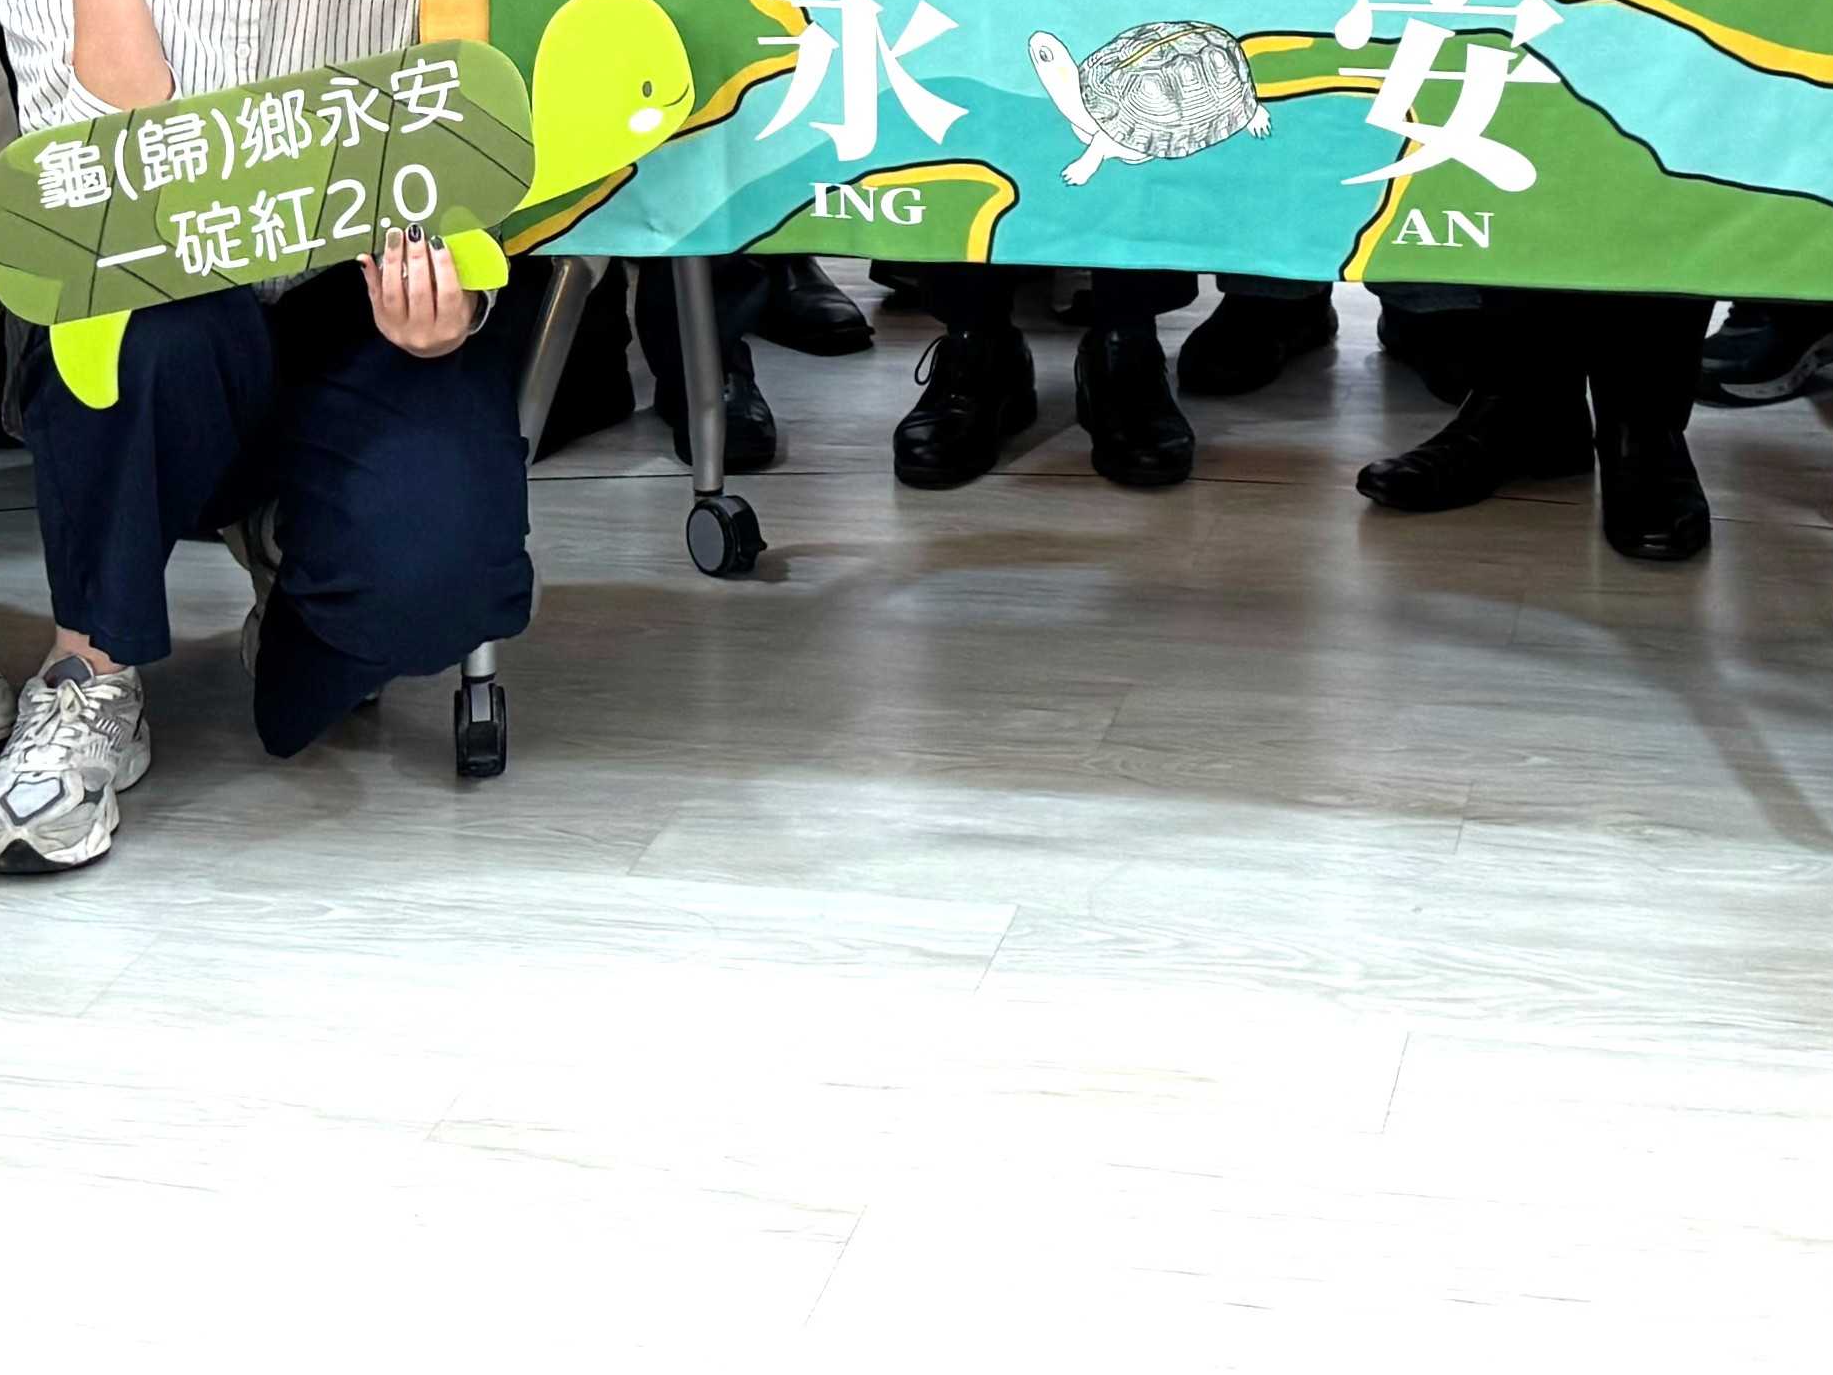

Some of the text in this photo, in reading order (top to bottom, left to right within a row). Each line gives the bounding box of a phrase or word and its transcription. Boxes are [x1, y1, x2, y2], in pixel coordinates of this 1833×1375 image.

[34, 58, 464, 209] 龜(歸)鄉永安
[96, 163, 438, 278] 一碇紅2.0
[810, 180, 1494, 249] ING AN
